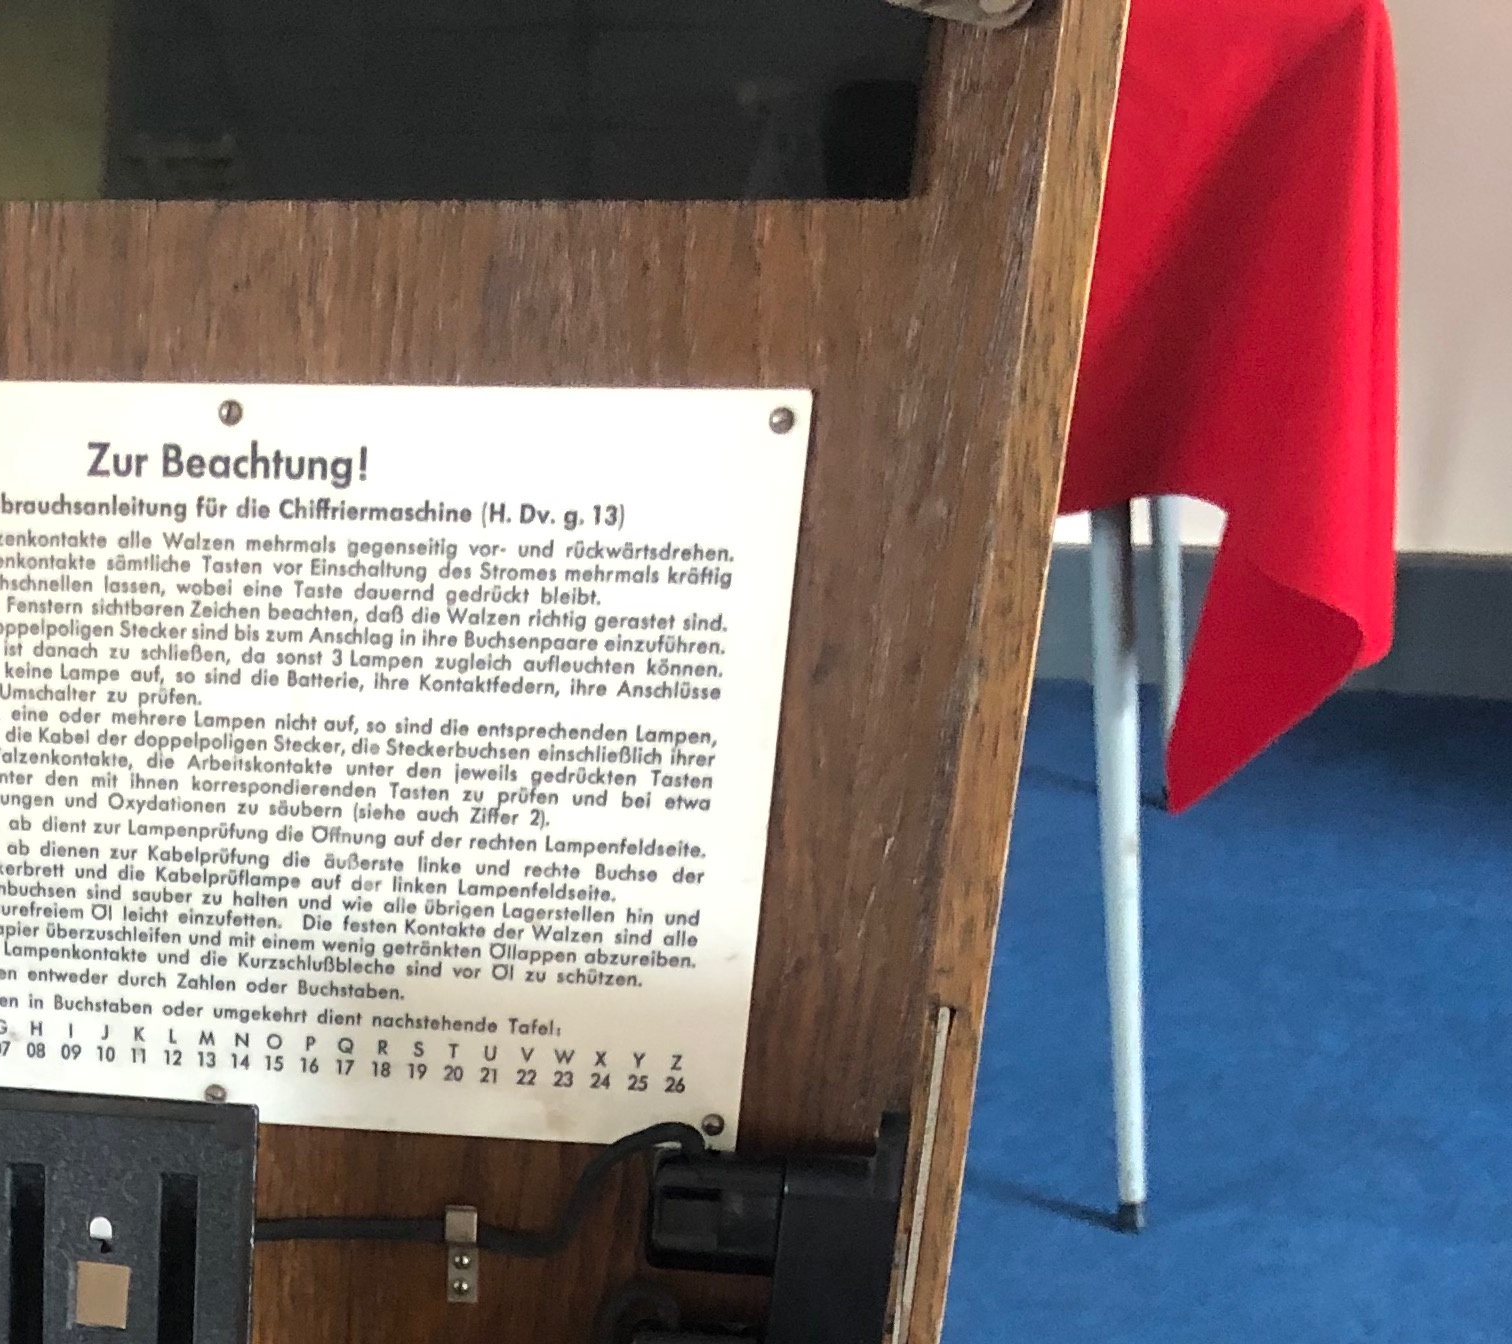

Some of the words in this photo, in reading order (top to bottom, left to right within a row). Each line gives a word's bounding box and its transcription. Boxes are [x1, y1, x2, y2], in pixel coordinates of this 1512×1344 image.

[86, 440, 149, 478] Zur
[161, 439, 368, 489] Beachtung!
[195, 494, 228, 518] für
[235, 495, 271, 519] die
[277, 496, 472, 523] Chiffriermaschine
[481, 501, 512, 528] (H.
[518, 502, 555, 524] Dv.
[562, 509, 584, 531] g.
[592, 503, 625, 529] 13)
[117, 529, 152, 549] alle
[162, 531, 235, 551] Walzen
[245, 533, 336, 553] mehrmals
[346, 536, 458, 560] gegenseitig
[468, 543, 506, 557] vor-
[517, 538, 554, 558] und
[565, 539, 734, 562] rückwärtsdrehen.
[103, 574, 165, 597] lassen,
[175, 577, 232, 596] wobei
[242, 578, 283, 598] eine
[293, 579, 343, 599] Taste
[353, 581, 435, 602] dauernd
[445, 583, 530, 606] gedrückt
[540, 585, 601, 606] bleibt.
[106, 690, 128, 703] zu
[137, 686, 202, 708] prüfen.
[63, 791, 98, 809] und
[107, 791, 226, 815] Oxydationen
[236, 801, 259, 815] zu
[268, 799, 342, 818] säubern
[352, 801, 406, 823] (siehe
[415, 804, 459, 823] auch
[468, 805, 519, 825] Ziffer
[529, 807, 550, 830] 2).
[7, 813, 32, 831] ab
[41, 814, 86, 833] dient
[92, 821, 121, 835] zur
[127, 818, 268, 845] Lampenprüfung
[275, 823, 304, 843] die
[310, 824, 387, 849] Öffnung
[393, 828, 425, 847] auf
[429, 829, 463, 848] der
[468, 831, 537, 852] rechten
[544, 834, 706, 858] Lampenfeldseite.
[26, 966, 108, 985] entweder
[116, 968, 167, 988] durch
[175, 971, 236, 992] Zahlen
[245, 976, 288, 994] oder
[296, 978, 405, 1000] Buchstaben.
[28, 992, 44, 1009] in
[53, 993, 152, 1015] Buchstaben
[161, 999, 204, 1017] oder
[212, 1004, 308, 1024] umgekehrt
[315, 1007, 362, 1026] dient
[371, 1011, 498, 1033] nachstehende
[507, 1016, 561, 1037] Tafel:
